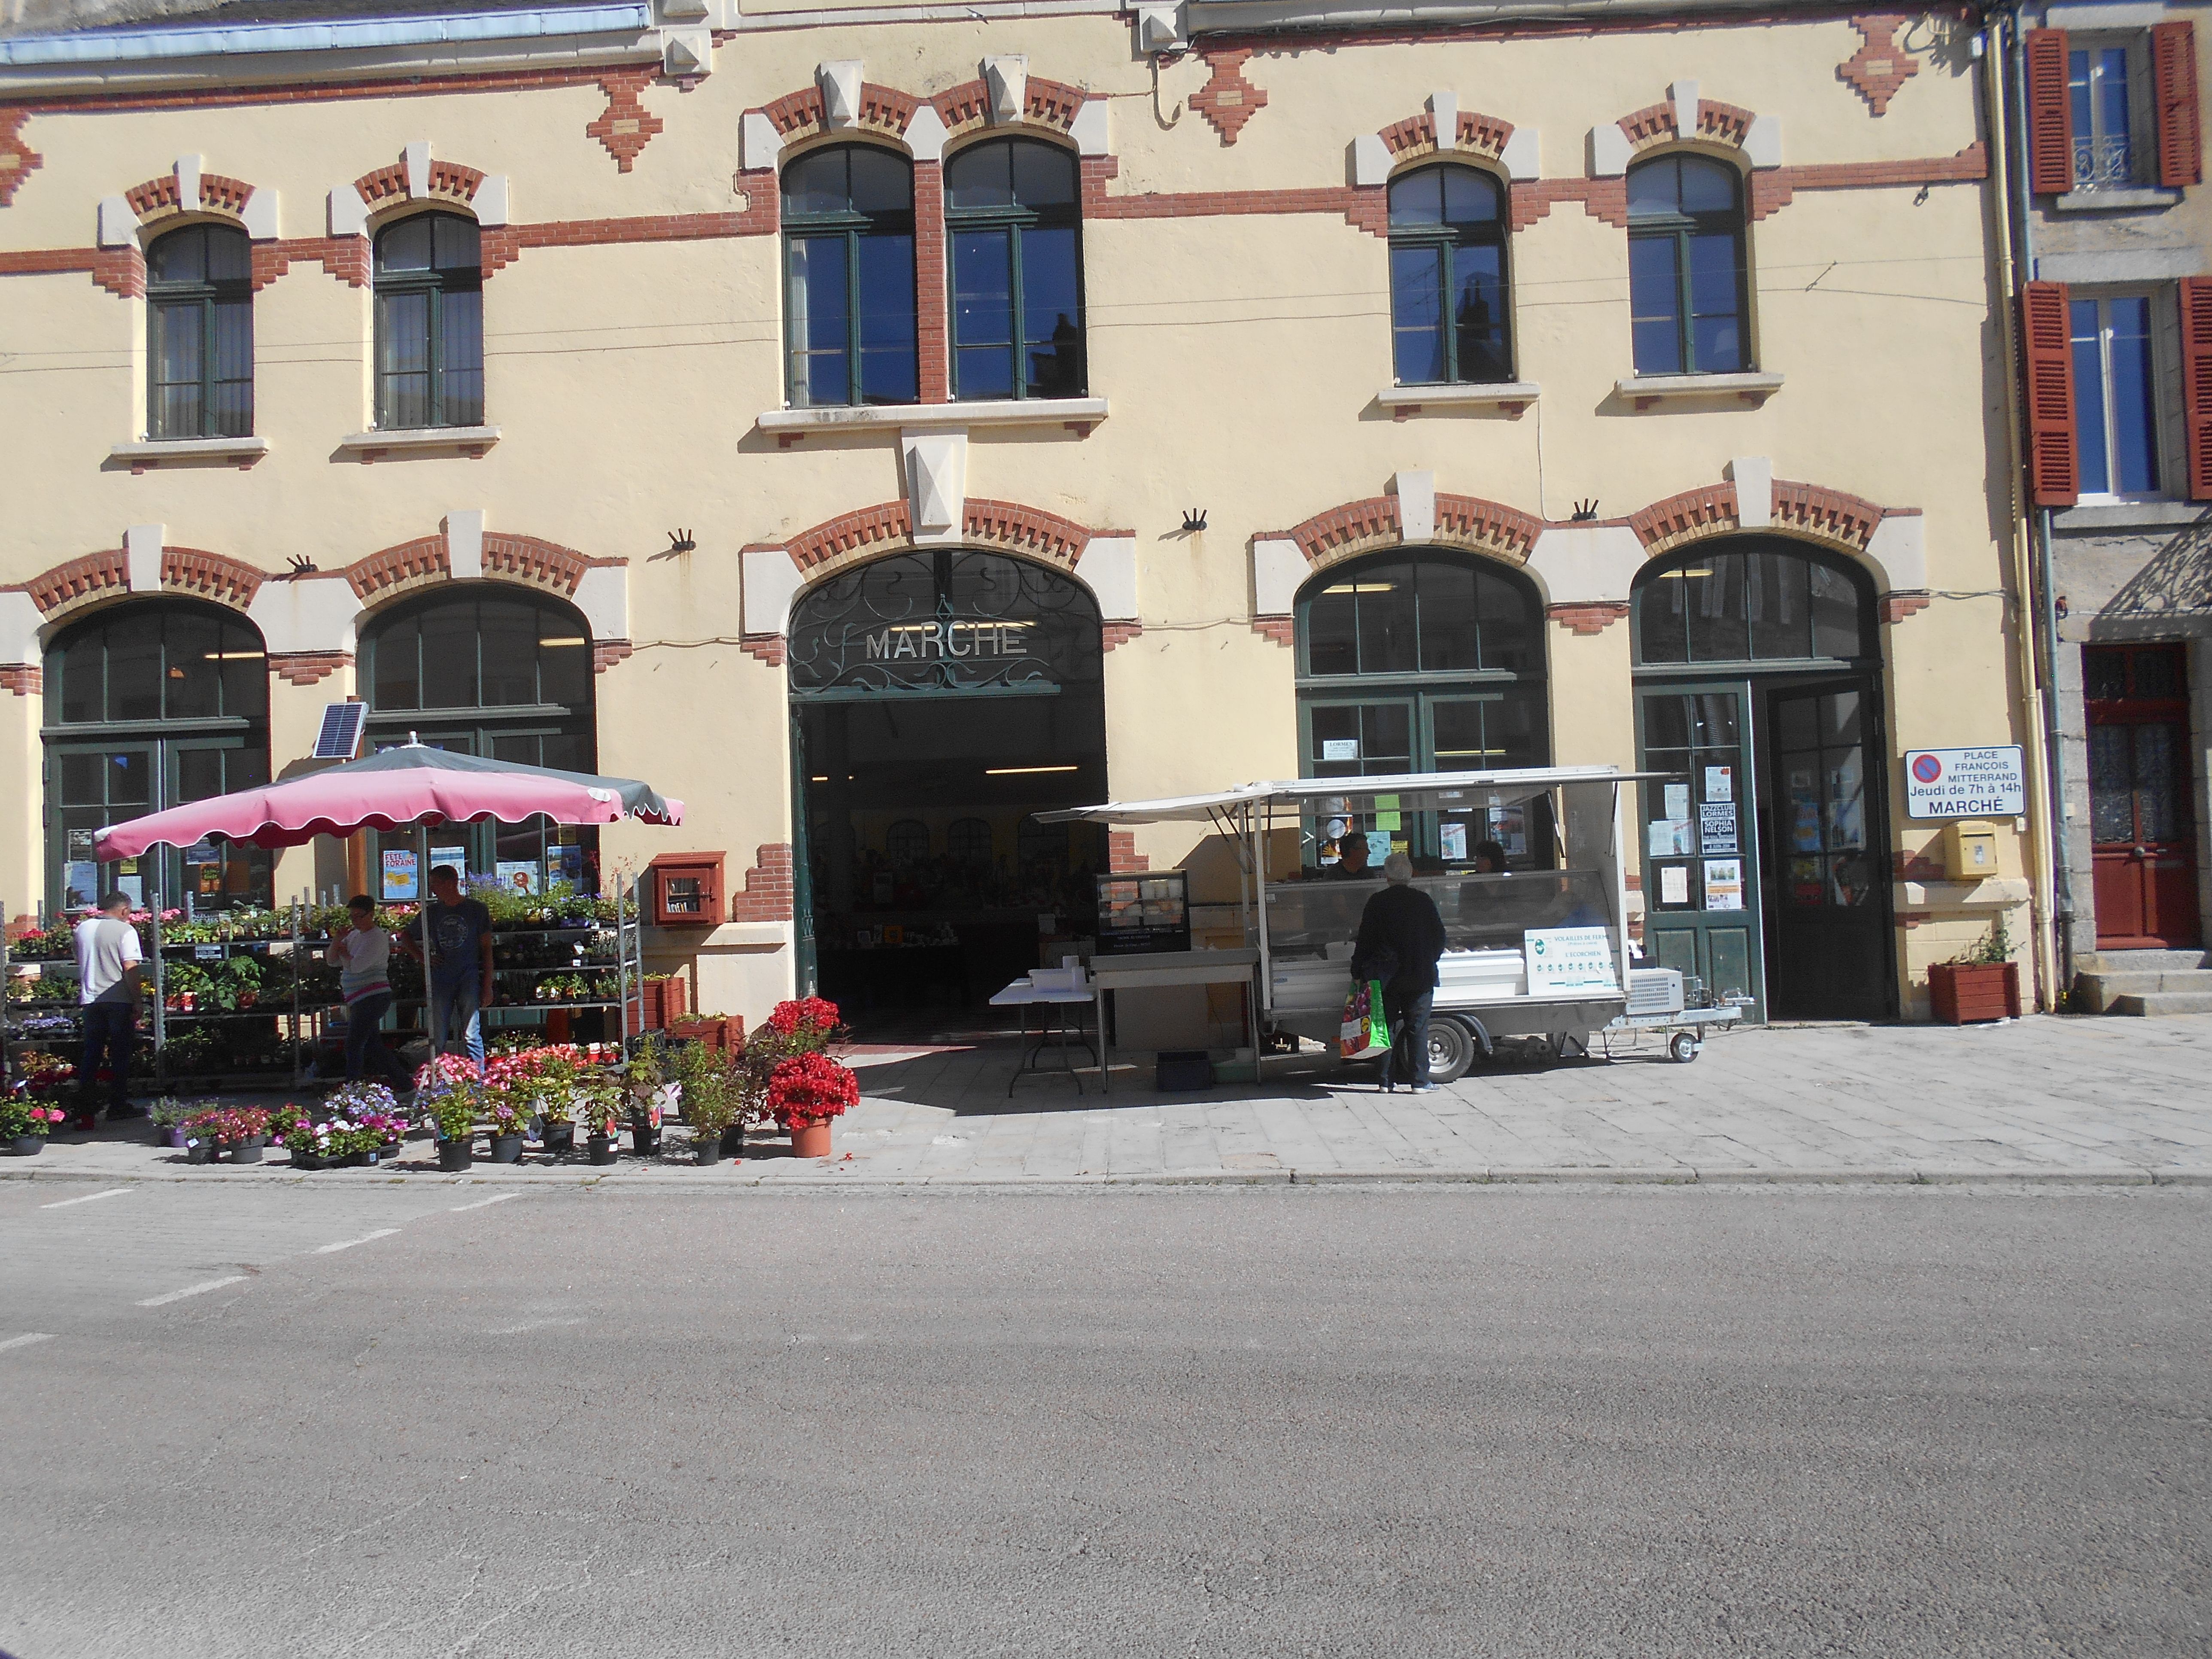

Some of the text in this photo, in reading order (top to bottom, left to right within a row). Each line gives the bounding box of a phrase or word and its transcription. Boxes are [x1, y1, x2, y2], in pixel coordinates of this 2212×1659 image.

[866, 620, 1027, 659] MARCHE
[1964, 751, 1998, 760] PLACE
[1955, 761, 2009, 771] FRANÇOIS
[1948, 773, 2018, 783] MITTERRAND
[1910, 783, 2021, 796] Jeudi de 7h à 14h
[1929, 796, 2004, 814] MARCHÉ
[385, 852, 403, 860] FÊTE
[385, 859, 416, 867] FORAINE
